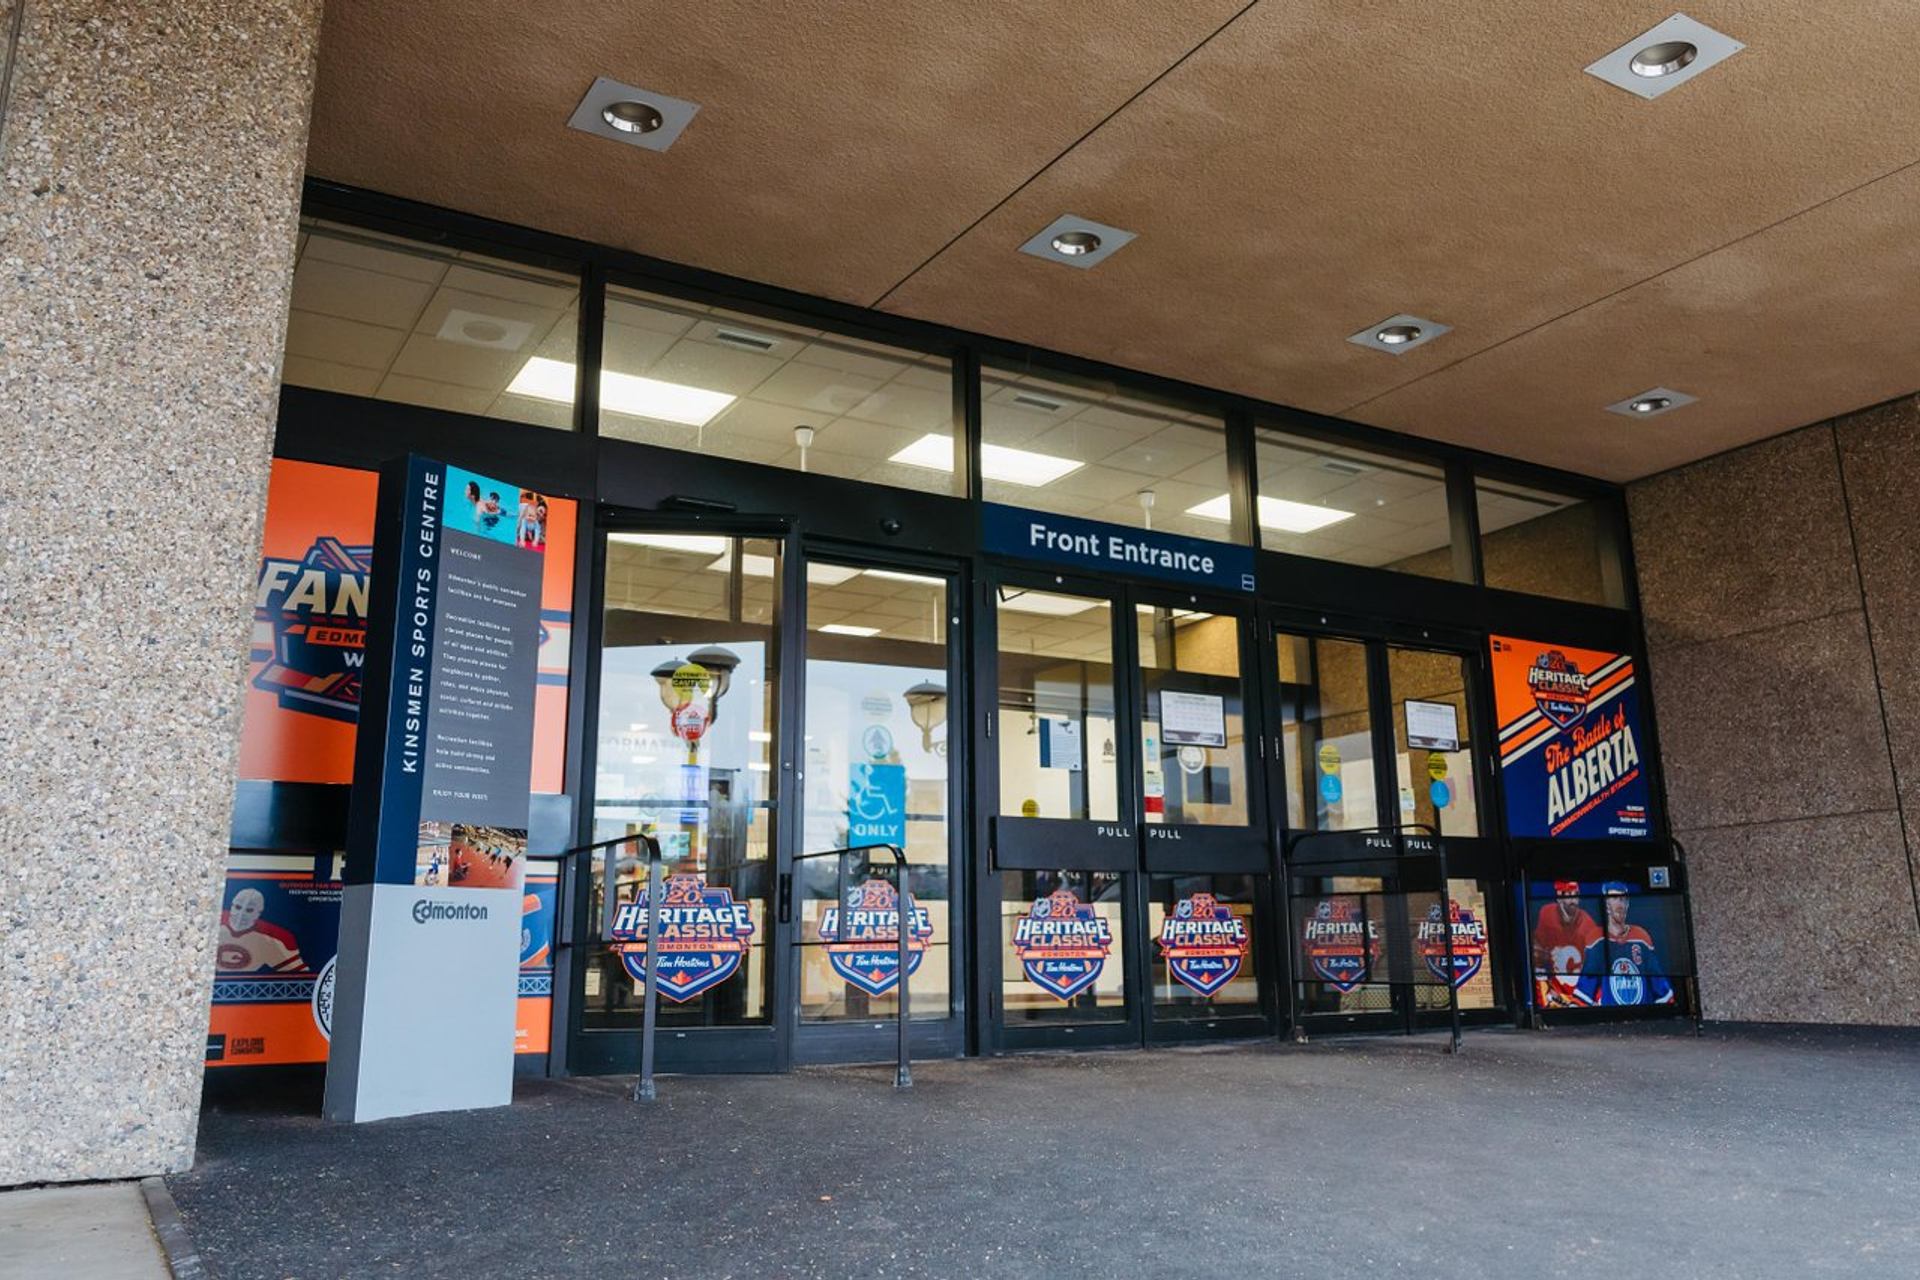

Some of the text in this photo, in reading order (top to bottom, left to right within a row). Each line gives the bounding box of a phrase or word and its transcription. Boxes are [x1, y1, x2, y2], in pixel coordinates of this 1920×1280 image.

[1030, 523, 1215, 574] Front Entrance
[403, 472, 439, 773] KINSMEN SPORTS CENTRE
[1529, 667, 1590, 691] HERITAGE
[1545, 702, 1626, 774] The Battle of
[1548, 724, 1639, 826] ALBERTA
[854, 824, 898, 837] ONLY
[1097, 827, 1131, 838] PULL
[1149, 828, 1181, 840] PULL
[1366, 837, 1393, 848] PULL
[1407, 839, 1433, 850] PULL
[411, 899, 488, 925] Edmonton
[1016, 918, 1111, 940] HERITAGE
[1162, 918, 1247, 940] HERITAGE
[1031, 934, 1099, 947] CLASSIC
[1175, 934, 1236, 946] CLASSIC
[674, 955, 710, 969] Hortons
[855, 955, 869, 966] Tim
[1046, 961, 1084, 973] Tim Hortons
[1190, 960, 1224, 971] Tim Hortons
